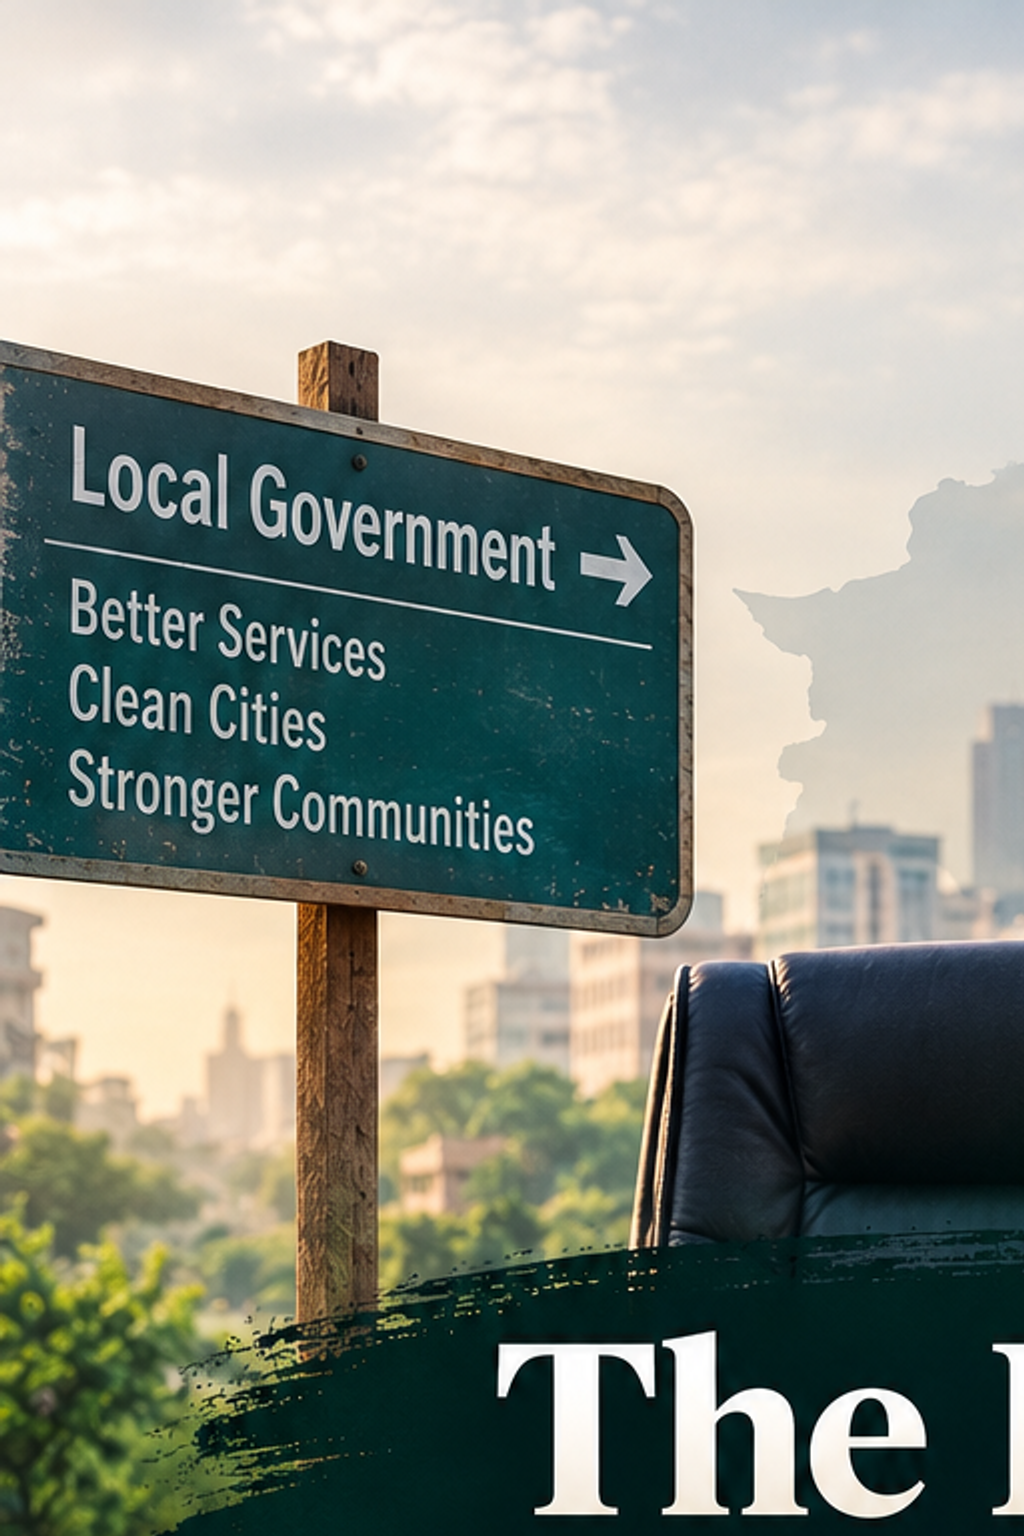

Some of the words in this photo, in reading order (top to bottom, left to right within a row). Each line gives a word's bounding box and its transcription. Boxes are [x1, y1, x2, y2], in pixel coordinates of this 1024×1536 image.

[72, 425, 228, 530] Local
[250, 464, 556, 591] Government
[71, 578, 204, 651] Better
[218, 603, 386, 681] Services
[69, 664, 192, 734] Clean
[210, 684, 326, 752] Cities
[69, 749, 259, 834] Stronger
[273, 774, 535, 857] Communities
